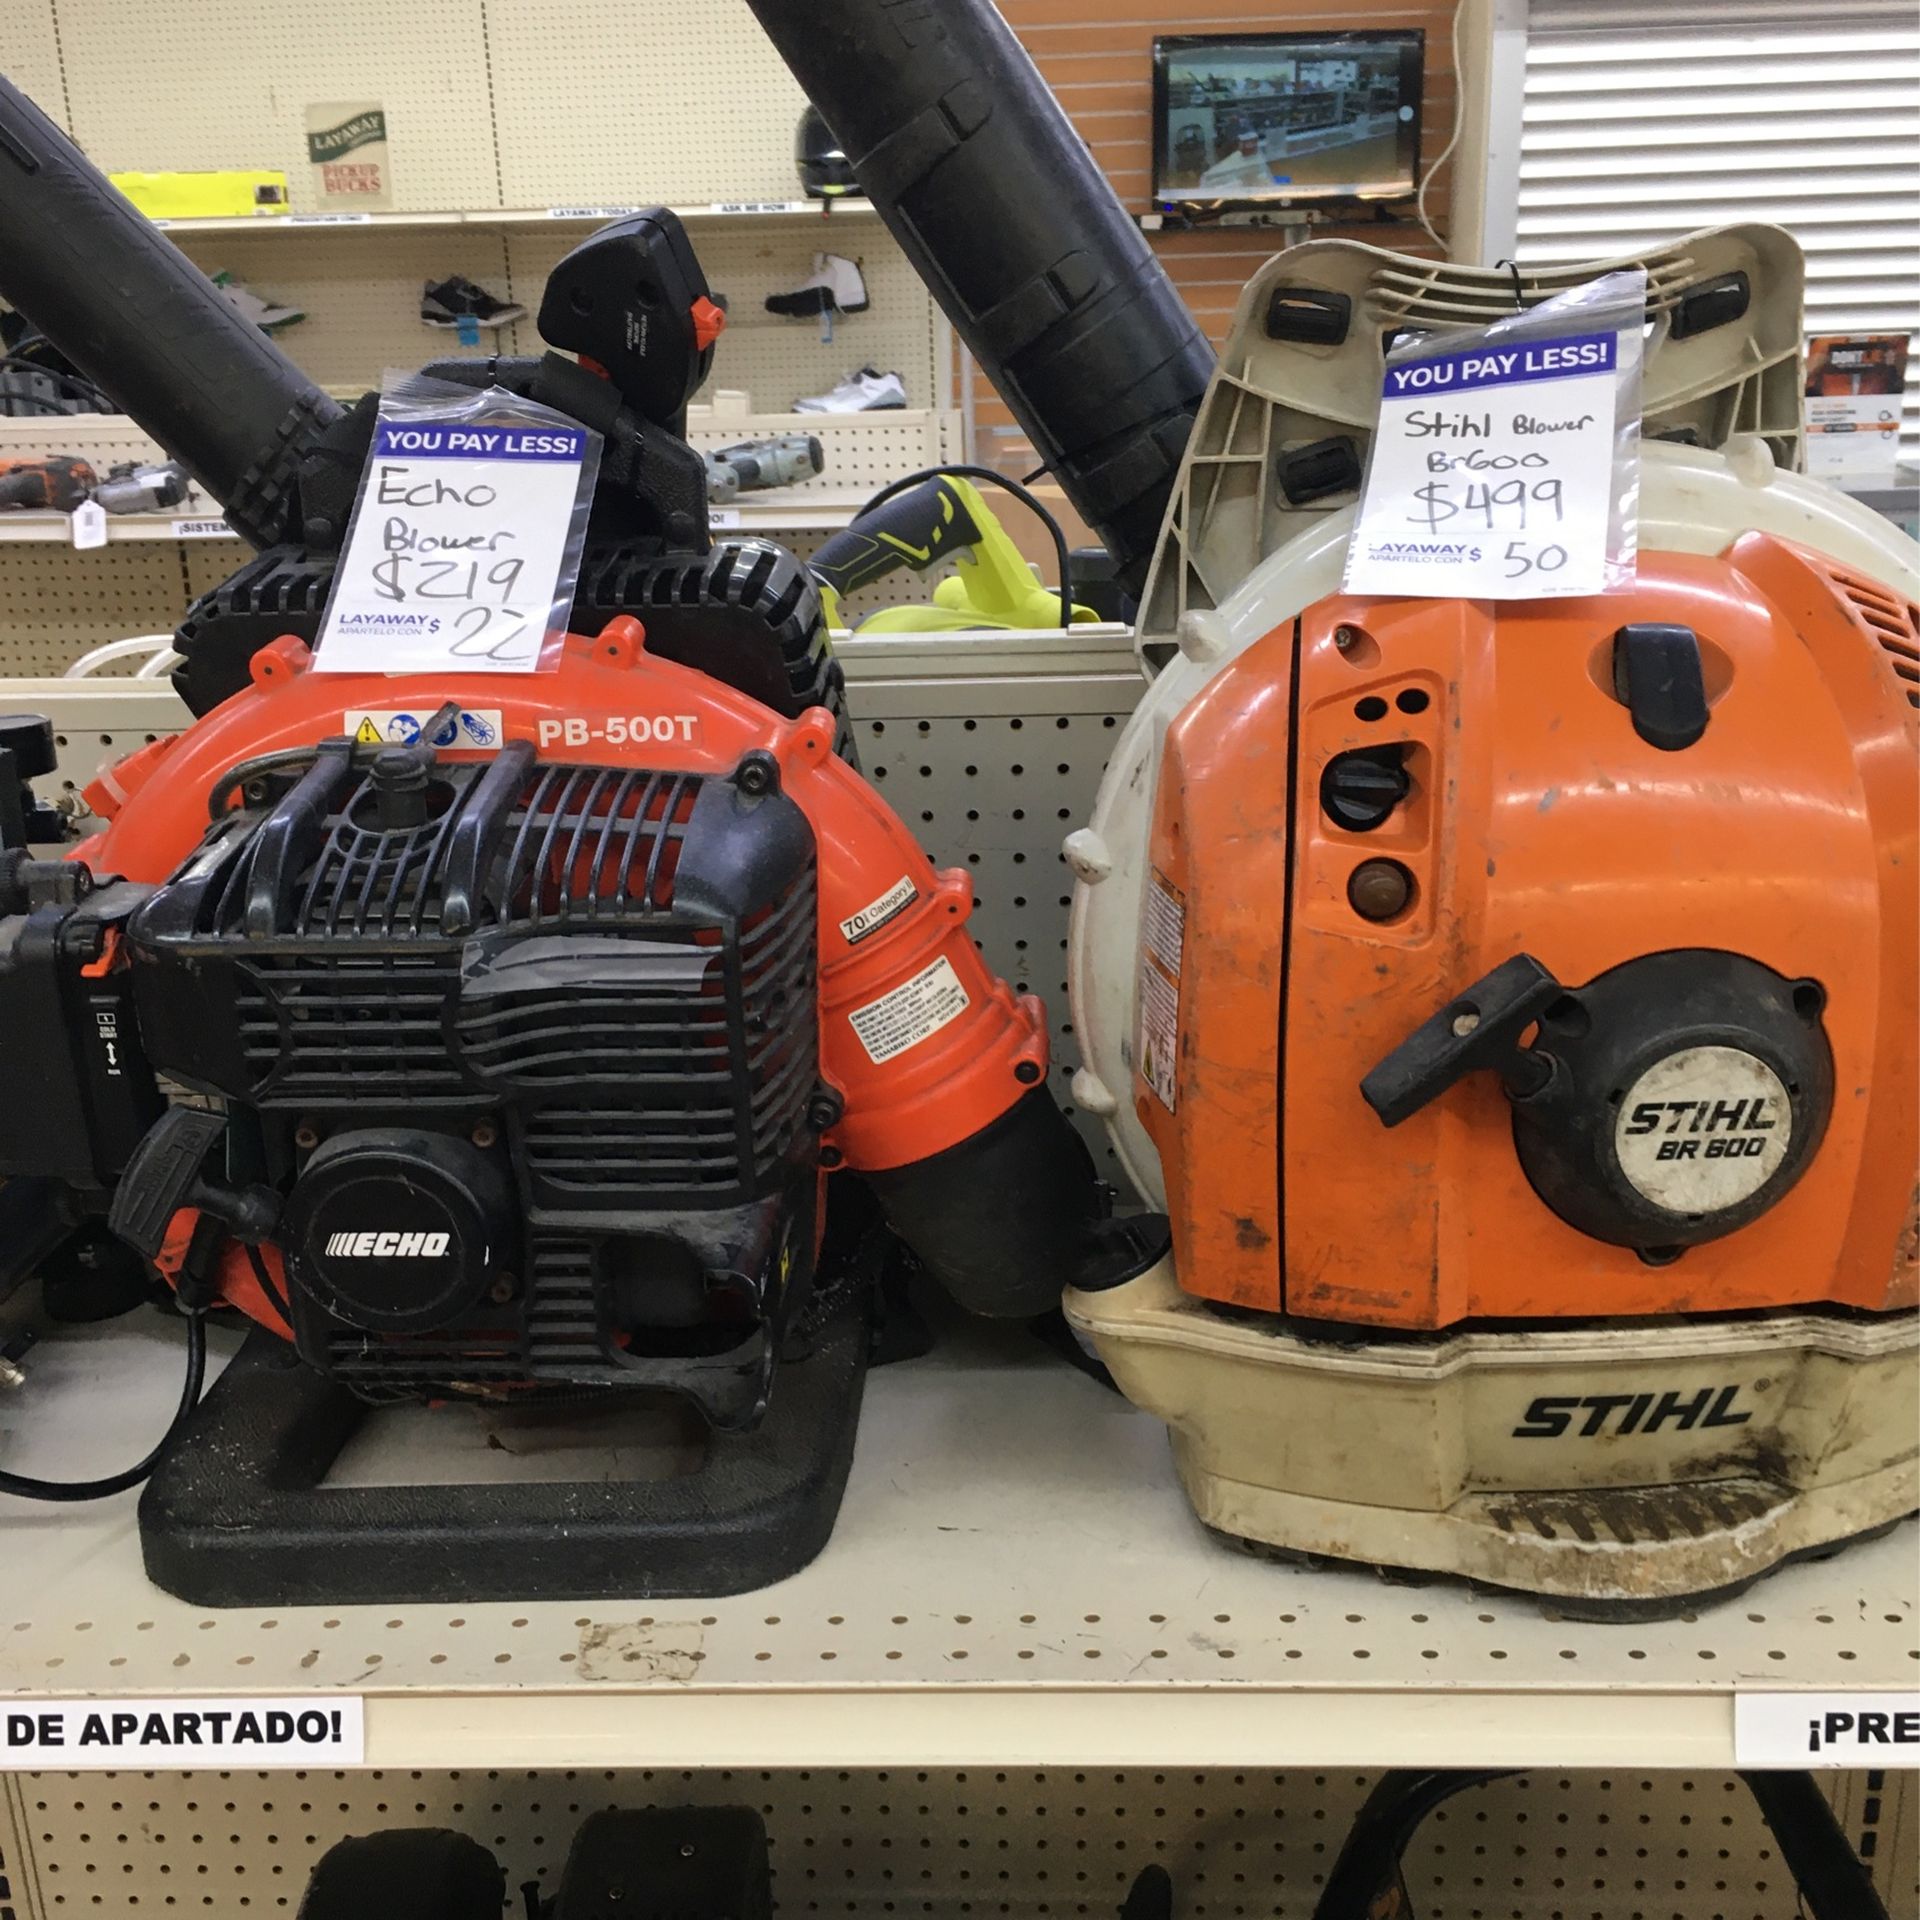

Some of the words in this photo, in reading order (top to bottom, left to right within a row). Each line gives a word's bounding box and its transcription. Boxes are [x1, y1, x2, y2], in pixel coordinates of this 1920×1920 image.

[314, 116, 380, 150] LAYAWAY
[722, 204, 742, 212] ASK
[745, 204, 759, 212] ME
[1394, 362, 1454, 389] YOU
[1462, 353, 1519, 381] PAY
[1525, 342, 1608, 373] LESS!
[1405, 410, 1491, 438] Stihl
[1512, 414, 1595, 436] Blower
[386, 430, 442, 450] YOU
[448, 433, 501, 452] PAY
[504, 435, 578, 455] LESS!
[377, 465, 498, 507] Echo
[1406, 479, 1564, 535] $499
[383, 516, 516, 553] Blower
[1434, 556, 1463, 564] CON
[1503, 542, 1569, 578] 50
[372, 552, 525, 604] $219
[339, 614, 429, 625] LAYAWAY
[397, 627, 422, 636] CON
[538, 715, 698, 748] PB-500T
[843, 915, 865, 935] 70
[870, 885, 908, 918] Category
[1625, 1098, 1776, 1135] STIHL
[1656, 1140, 1702, 1160] BR
[1704, 1137, 1767, 1158] 600
[351, 1232, 450, 1257] ECHO
[1512, 1385, 1753, 1437] STIHL
[7, 1714, 65, 1747] DE
[79, 1710, 342, 1746] APARTADO!
